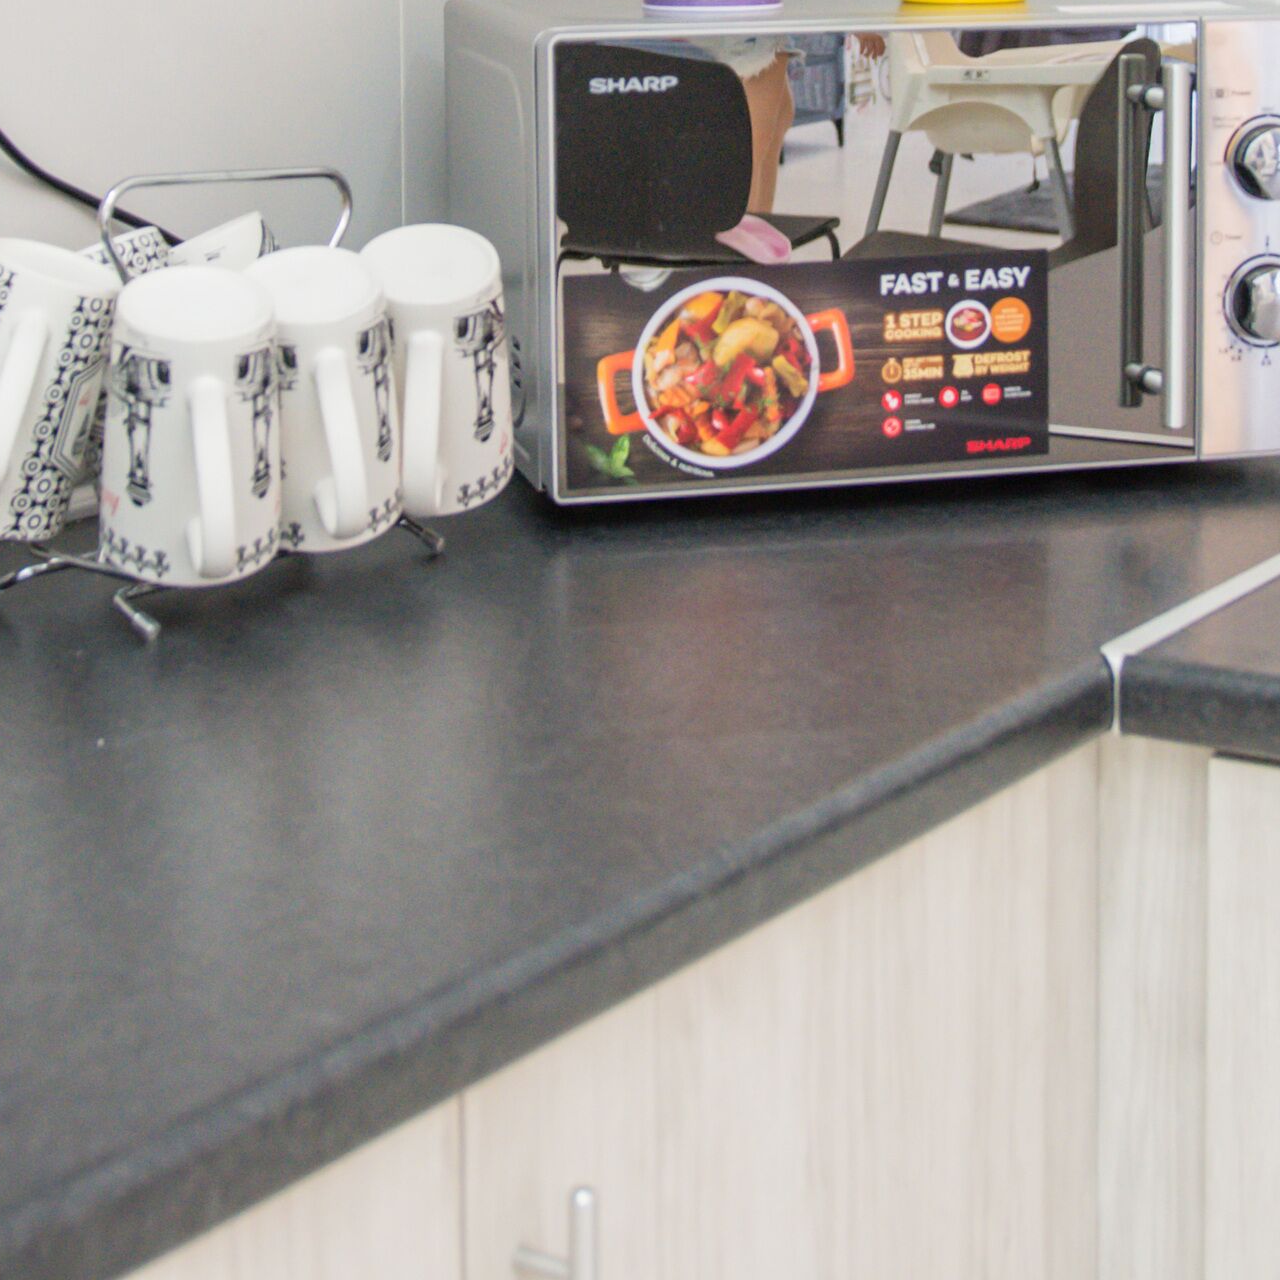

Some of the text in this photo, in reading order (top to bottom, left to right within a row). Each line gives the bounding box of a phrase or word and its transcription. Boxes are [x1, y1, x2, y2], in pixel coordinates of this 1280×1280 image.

[589, 75, 679, 95] SHARP
[880, 266, 1031, 296] FAST & EASY
[885, 309, 944, 329] 1 STEP
[884, 326, 943, 340] COOKING
[974, 350, 1031, 364] DEFROST
[966, 436, 1031, 453] SHARP
